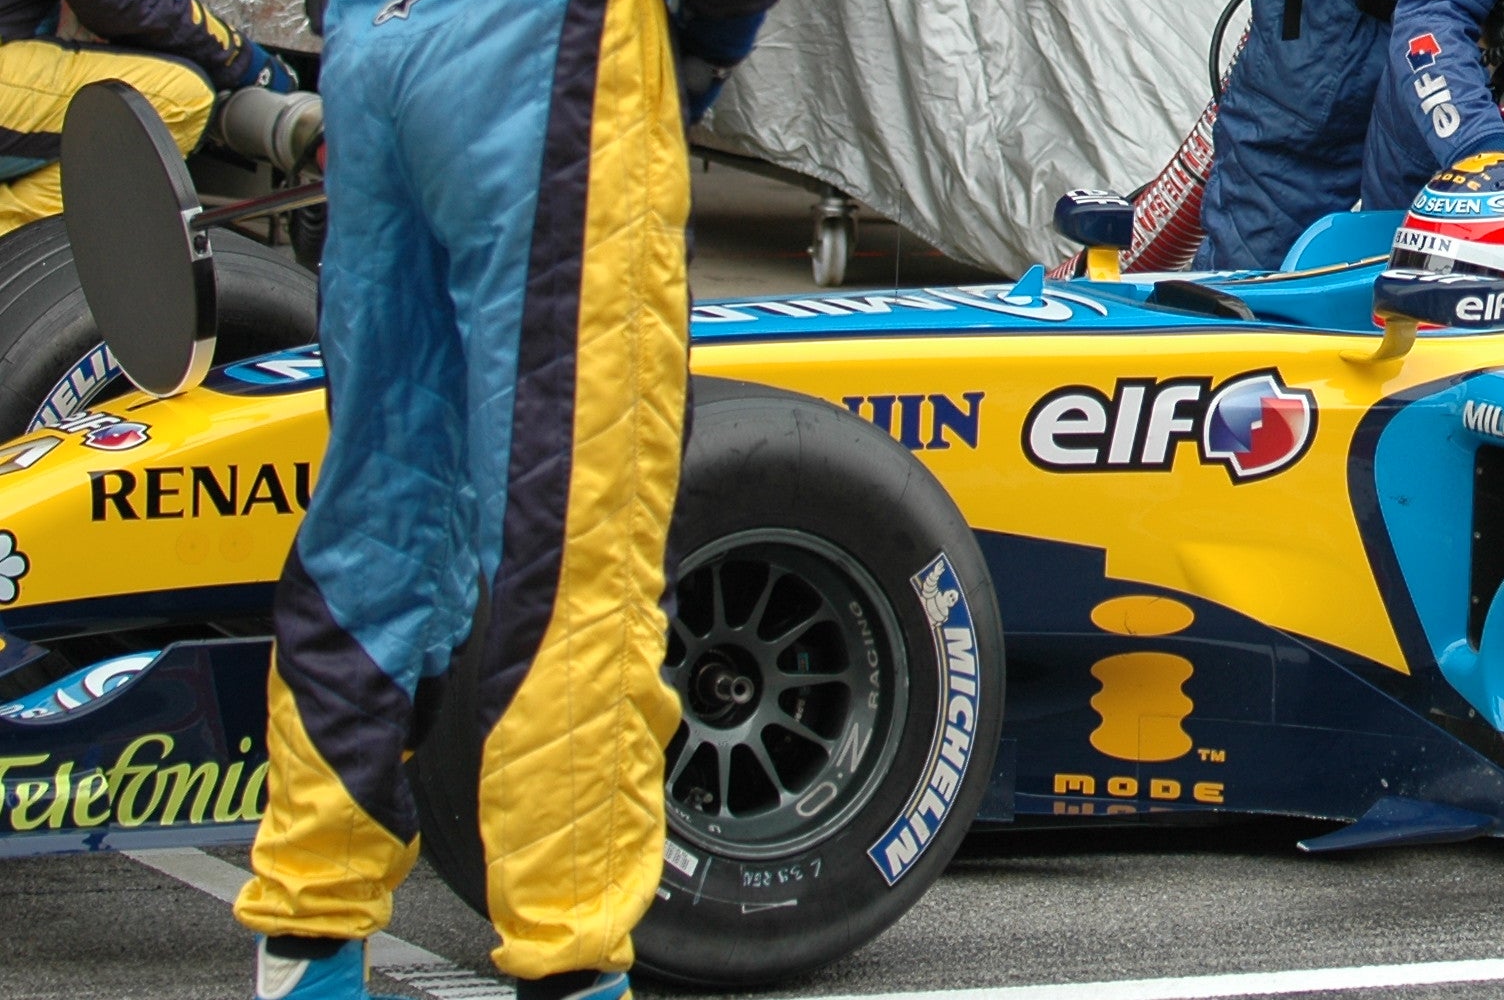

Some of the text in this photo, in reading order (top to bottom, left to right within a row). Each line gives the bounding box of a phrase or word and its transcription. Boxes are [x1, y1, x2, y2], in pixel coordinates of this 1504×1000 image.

[1414, 74, 1462, 139] elf
[1427, 197, 1481, 215] SEVEN
[1029, 384, 1200, 465] elf
[88, 463, 313, 522] RENAU
[849, 600, 880, 712] RACING
[0, 733, 270, 831] Telefonic
[885, 625, 978, 877] MICHELIN
[1198, 748, 1226, 762] TM
[1054, 773, 1225, 803] MODE
